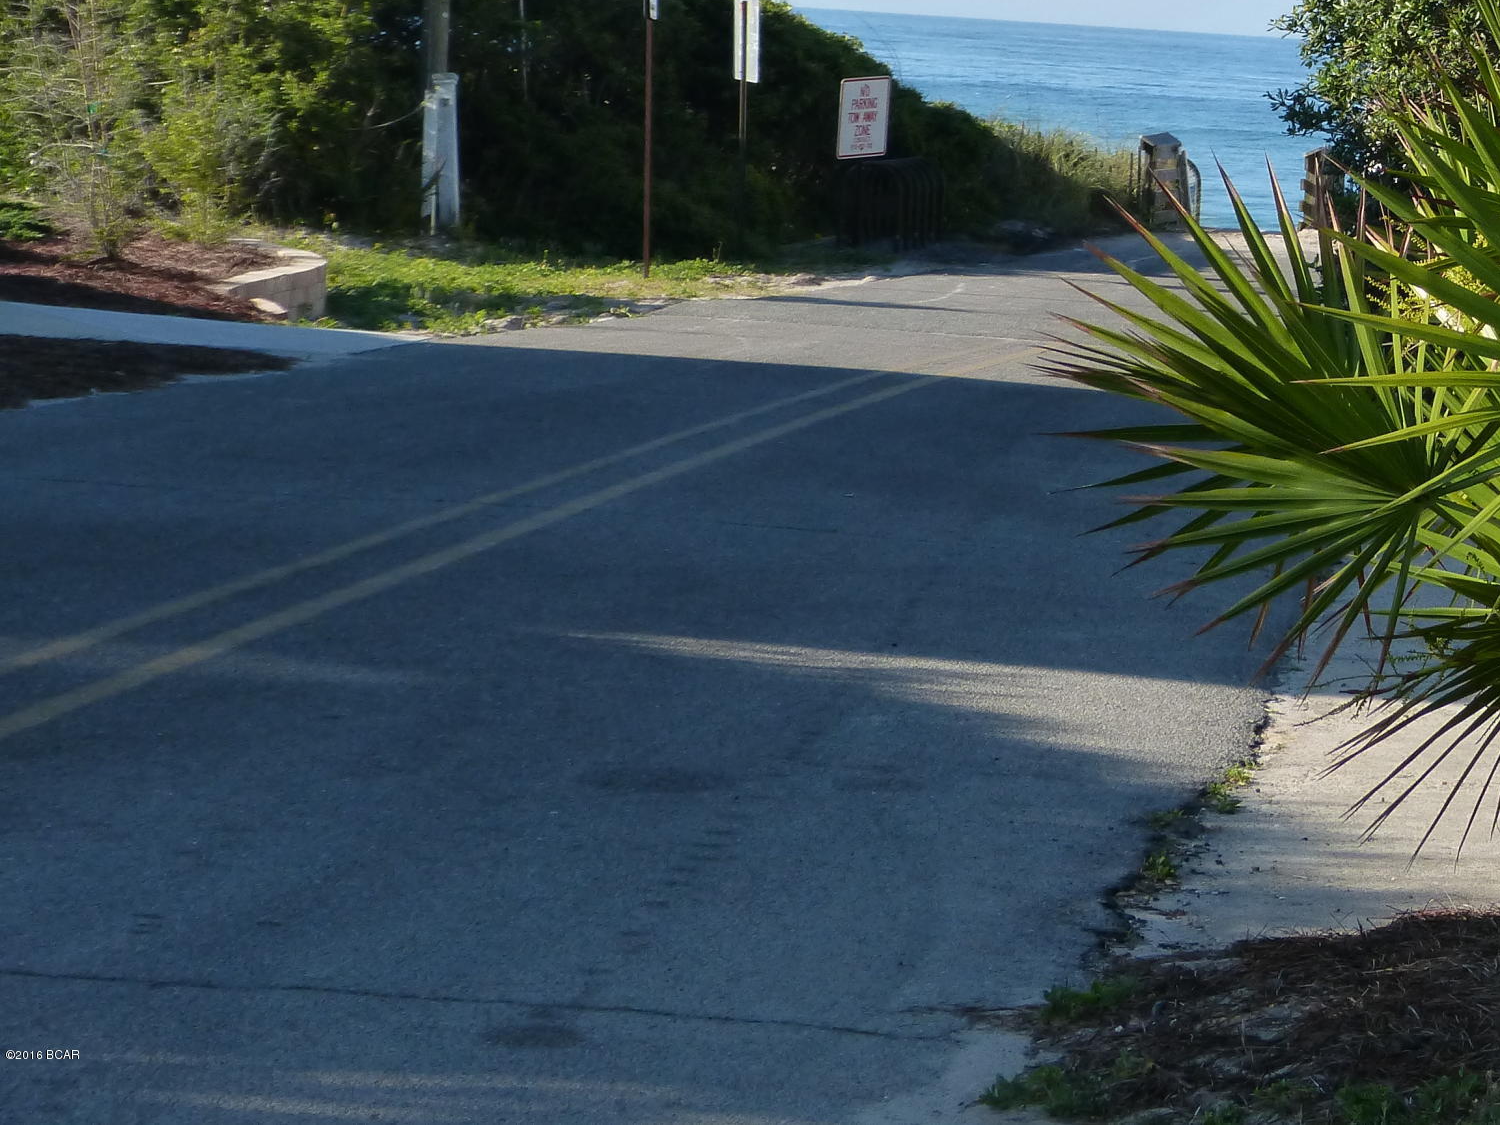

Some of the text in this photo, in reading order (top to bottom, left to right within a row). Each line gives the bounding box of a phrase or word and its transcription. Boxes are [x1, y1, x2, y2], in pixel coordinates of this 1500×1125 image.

[851, 98, 878, 111] PARKING
[848, 110, 878, 124] TOW AWAY
[854, 123, 872, 137] ZONE
